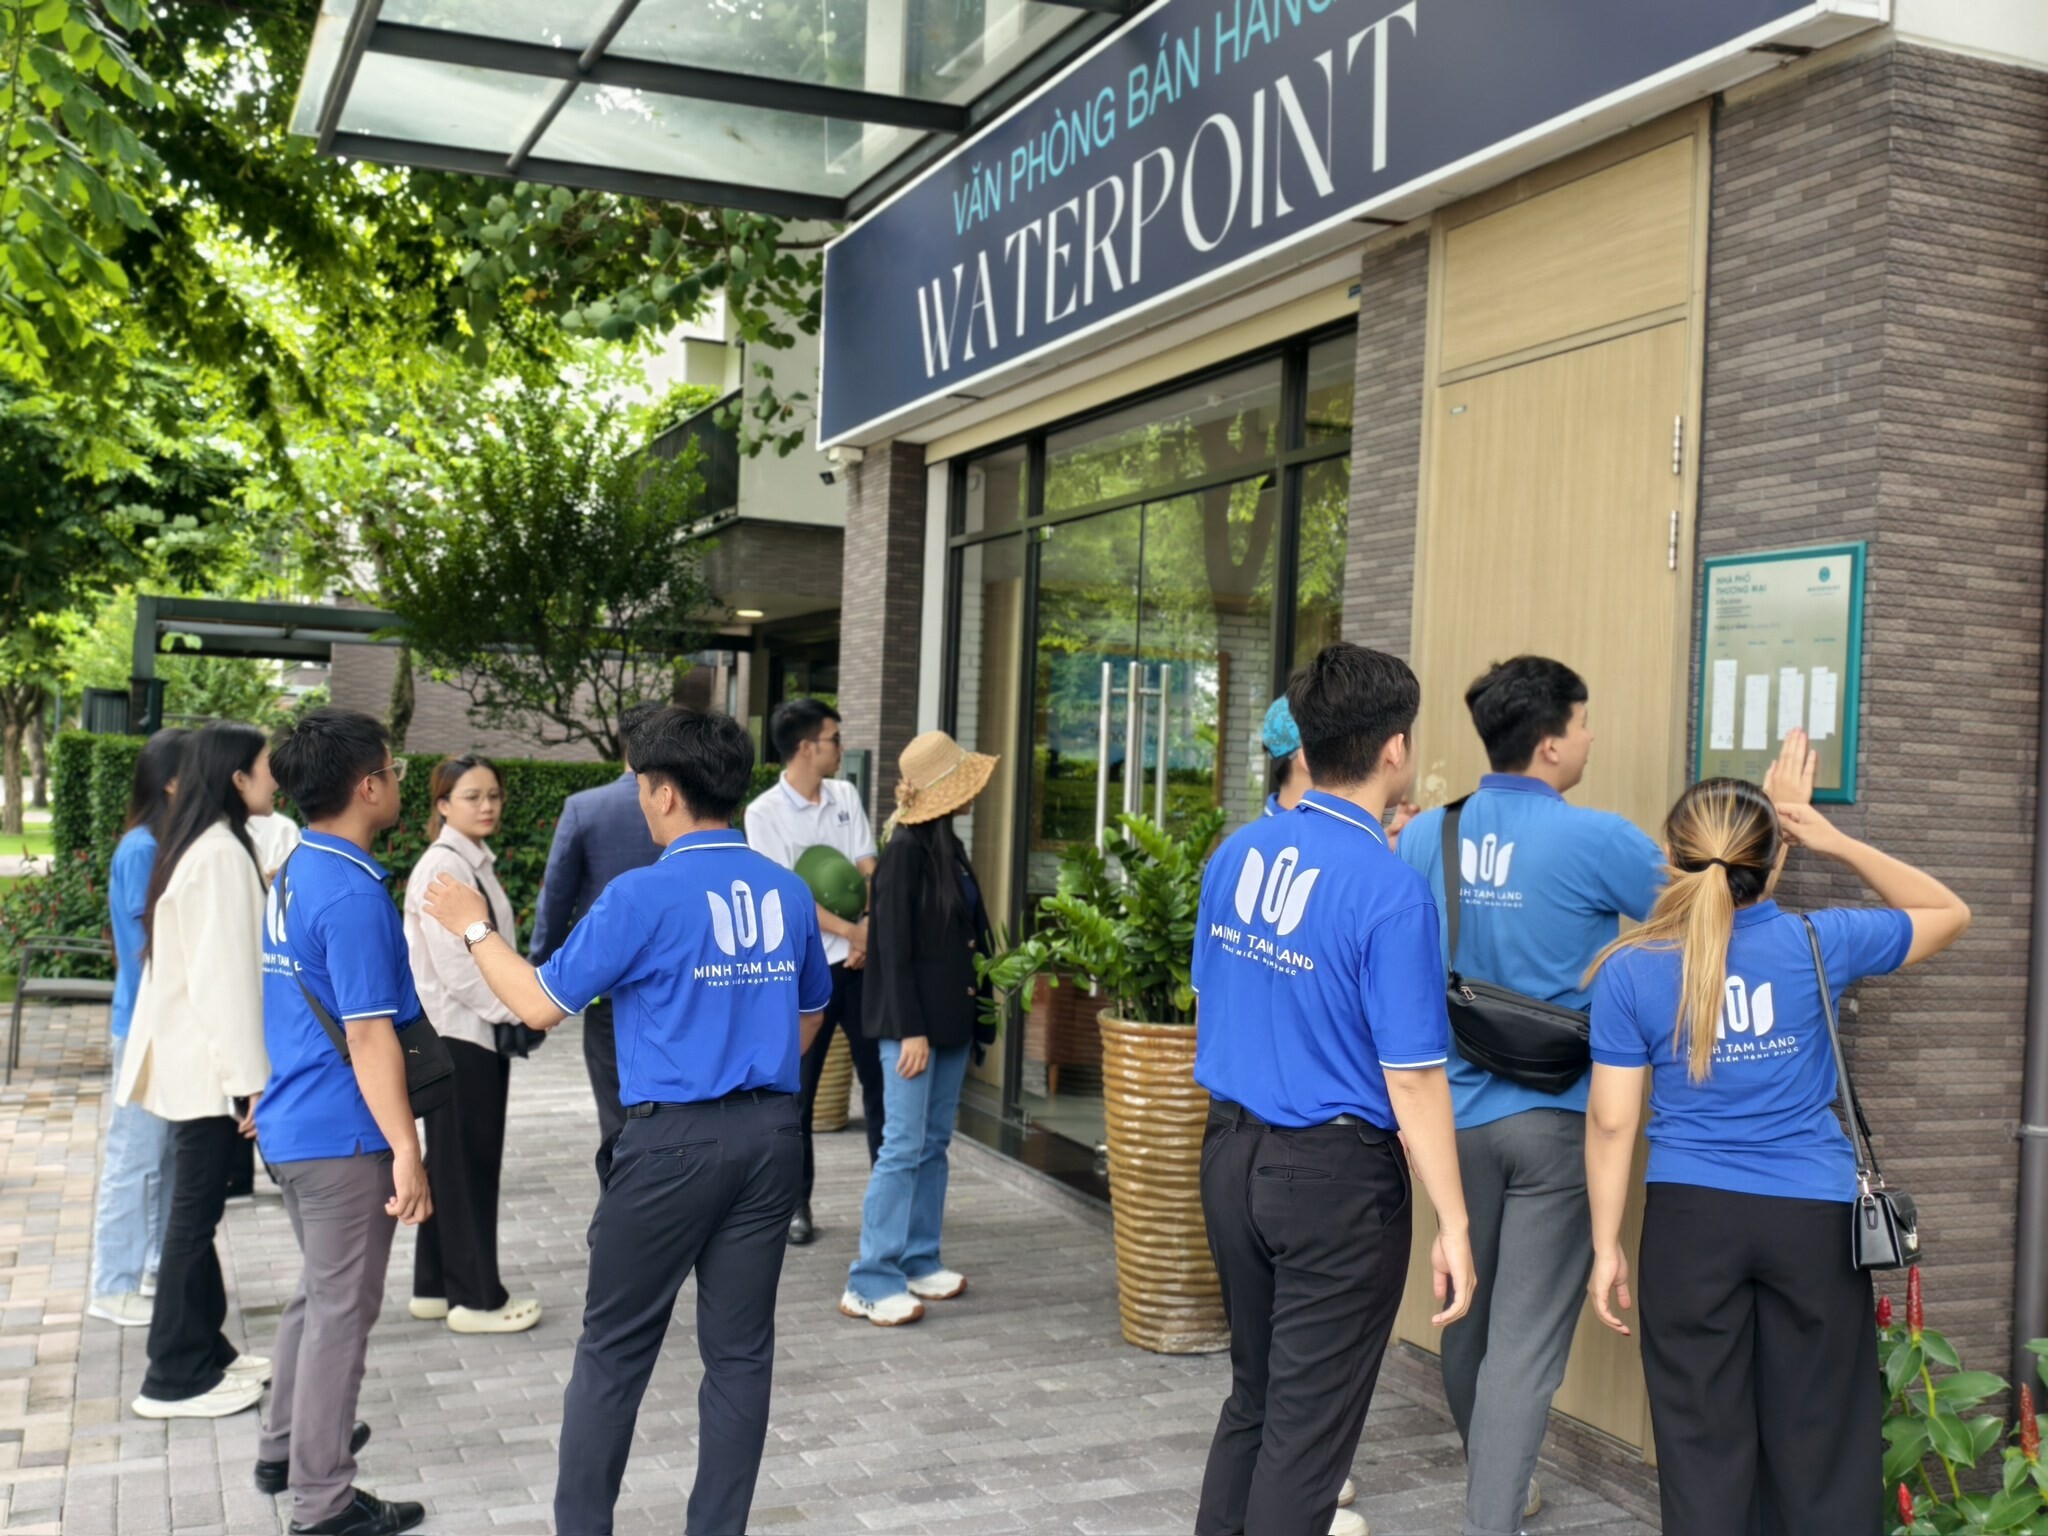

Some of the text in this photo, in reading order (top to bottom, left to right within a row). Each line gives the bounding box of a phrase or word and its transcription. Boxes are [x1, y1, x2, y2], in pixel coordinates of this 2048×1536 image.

[953, 160, 1002, 236] VĂN
[1009, 86, 1116, 203] PHÒNG
[1127, 26, 1200, 129] BÁN
[917, 2, 1417, 379] WATERPOINT
[1473, 889, 1495, 899] TAM
[1496, 891, 1522, 900] LAND
[1211, 923, 1314, 970] MINH TAM LAND
[694, 960, 796, 980] MINH TAM LAN
[1725, 1041, 1755, 1054] TAM
[1760, 1035, 1796, 1050] LAND
